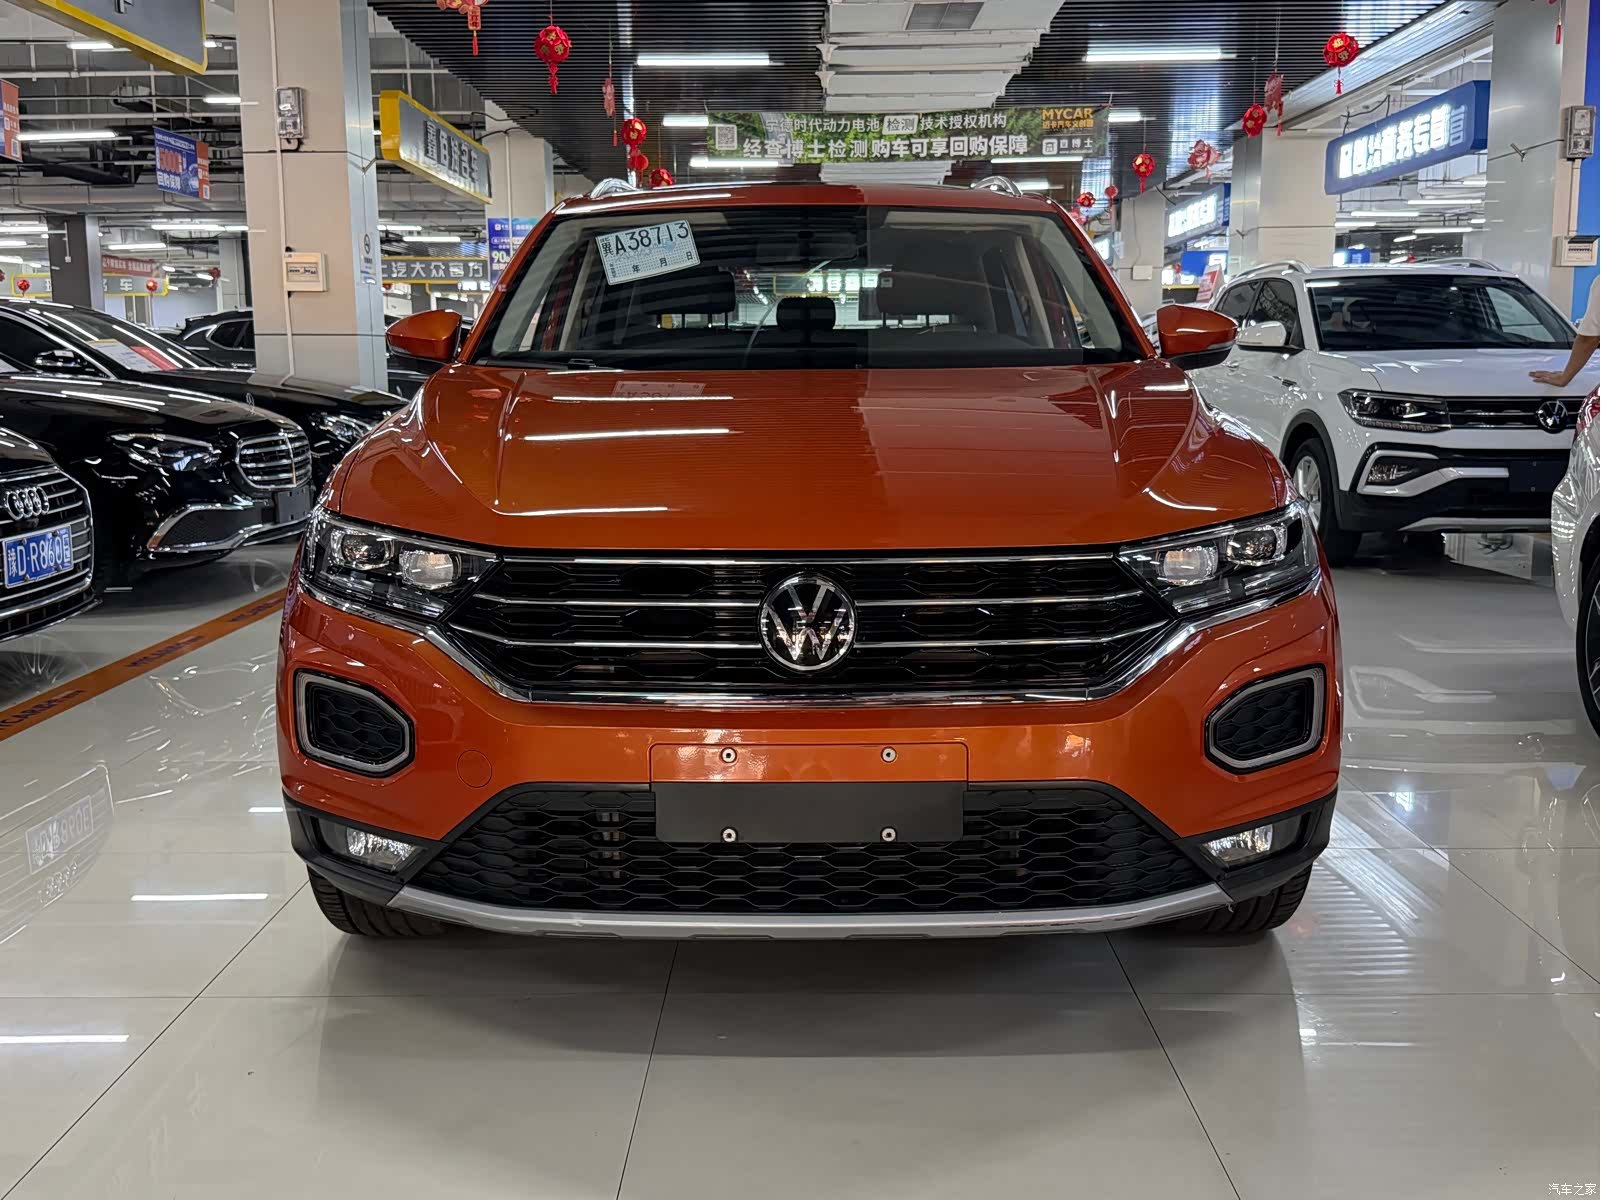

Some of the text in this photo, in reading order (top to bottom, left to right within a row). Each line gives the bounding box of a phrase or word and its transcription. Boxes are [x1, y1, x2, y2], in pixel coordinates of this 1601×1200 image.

[765, 113, 1007, 133] 宁德时代动力电池 检测 技术授权机构
[1042, 108, 1093, 120] MYCAR
[631, 251, 693, 273] 年 月 日
